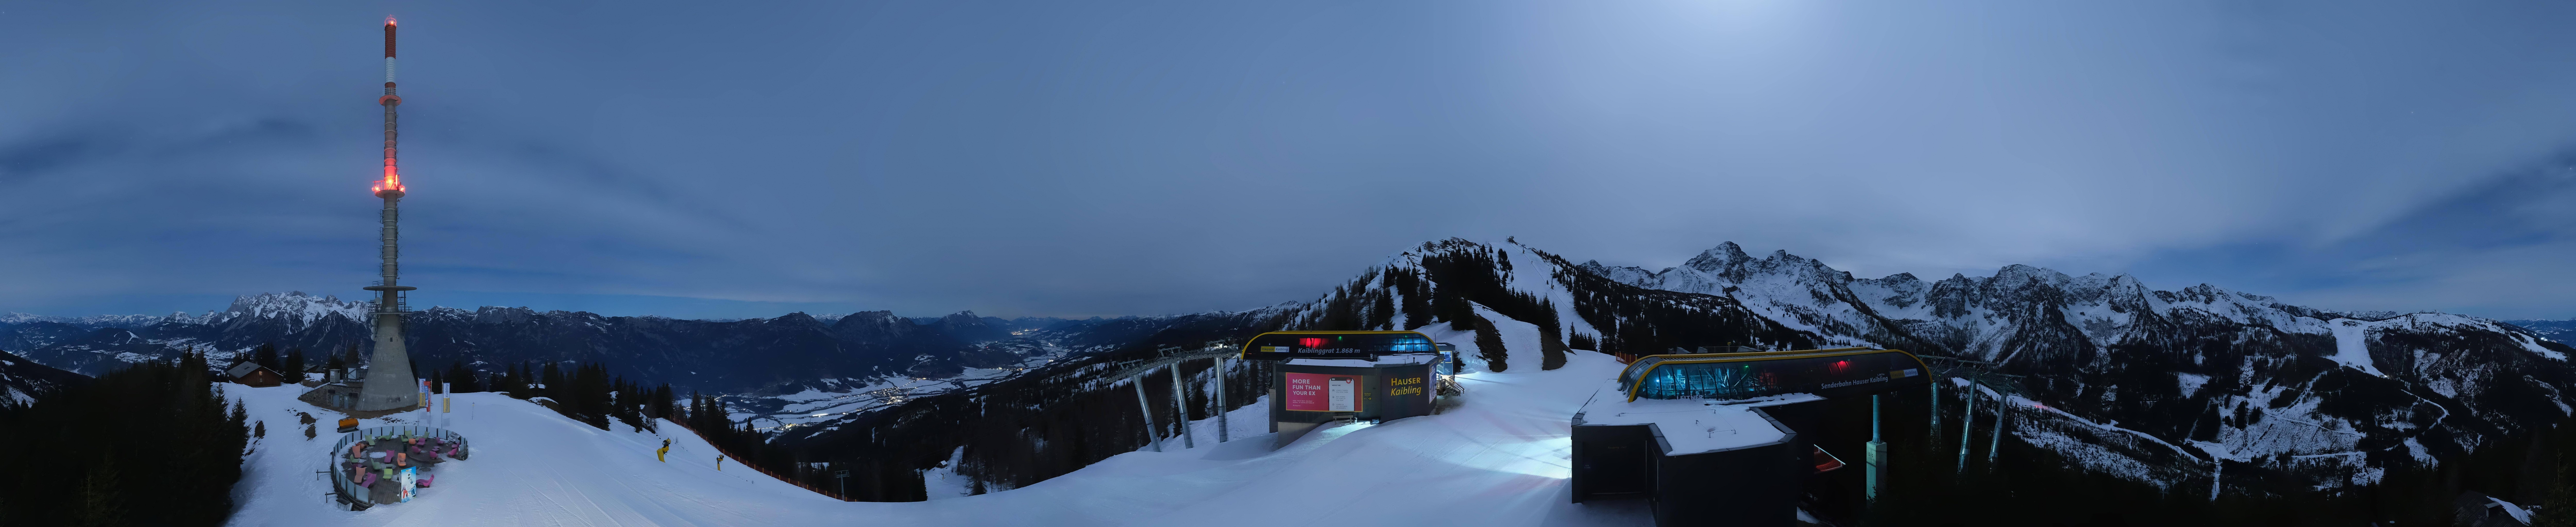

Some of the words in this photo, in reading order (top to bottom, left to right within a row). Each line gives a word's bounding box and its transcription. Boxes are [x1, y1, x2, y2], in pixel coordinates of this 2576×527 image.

[1391, 377, 1421, 386] HAUSER
[1821, 380, 1852, 389] Senderbahn
[1391, 386, 1421, 396] Kaibling
